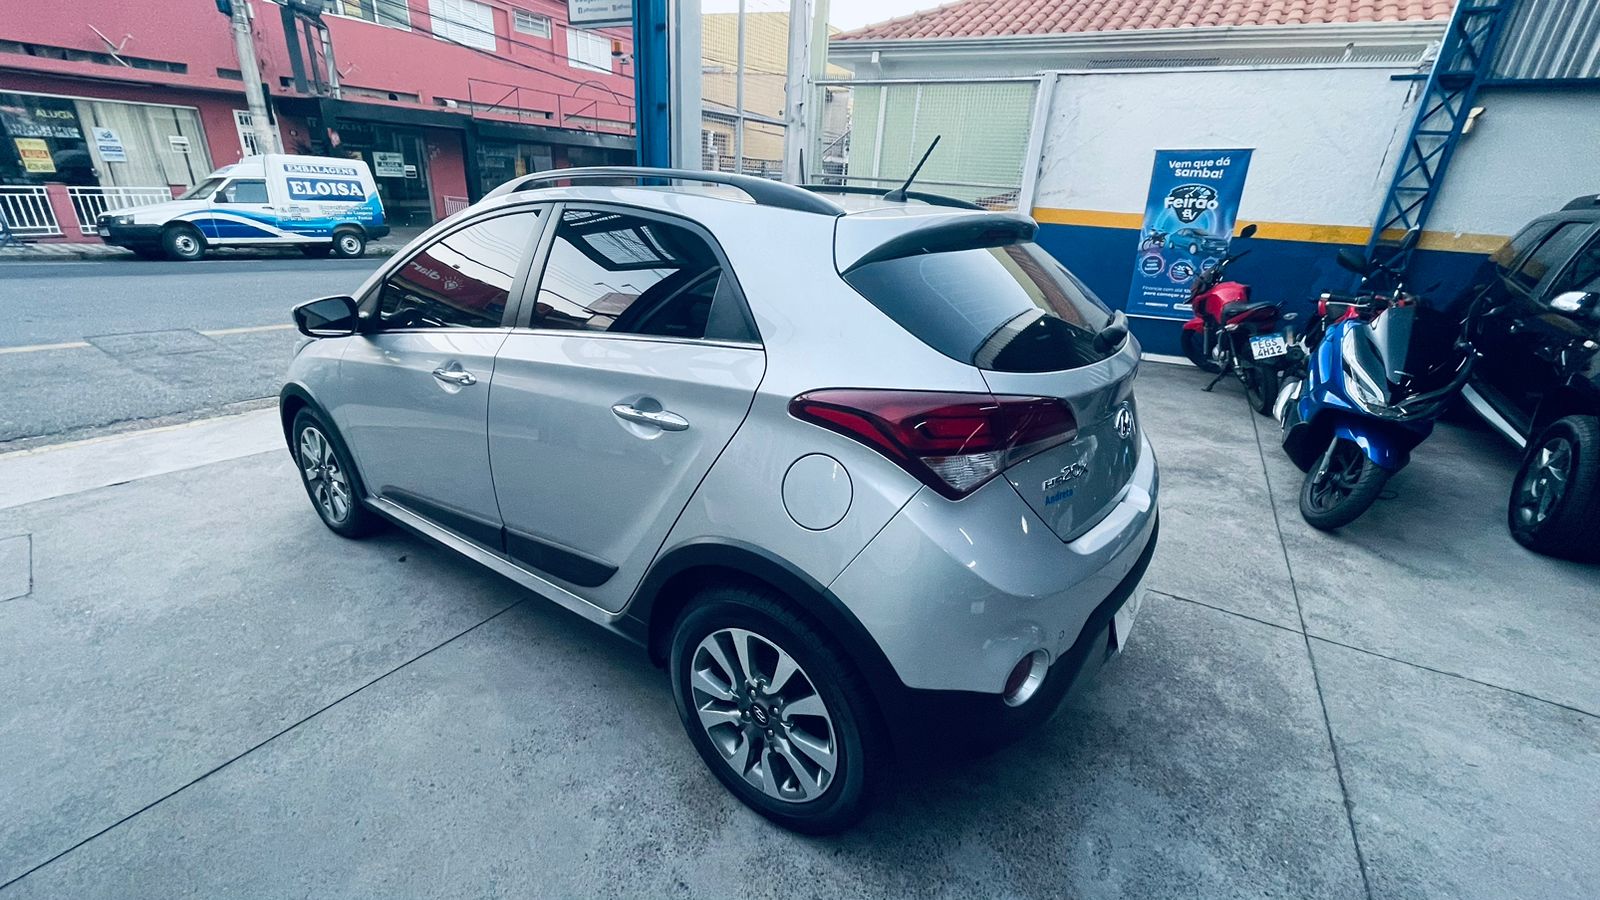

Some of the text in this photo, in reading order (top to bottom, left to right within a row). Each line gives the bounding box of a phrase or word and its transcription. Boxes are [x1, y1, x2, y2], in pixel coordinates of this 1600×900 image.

[35, 109, 75, 119] ALUGA
[1168, 156, 1231, 169] Vem que dá
[287, 164, 355, 175] EMBALAGENS
[1174, 167, 1224, 179] samba!
[289, 181, 364, 196] ELOISA
[1164, 194, 1219, 210] Feirão
[1258, 339, 1278, 349] EGS
[1258, 346, 1283, 356] 4H12
